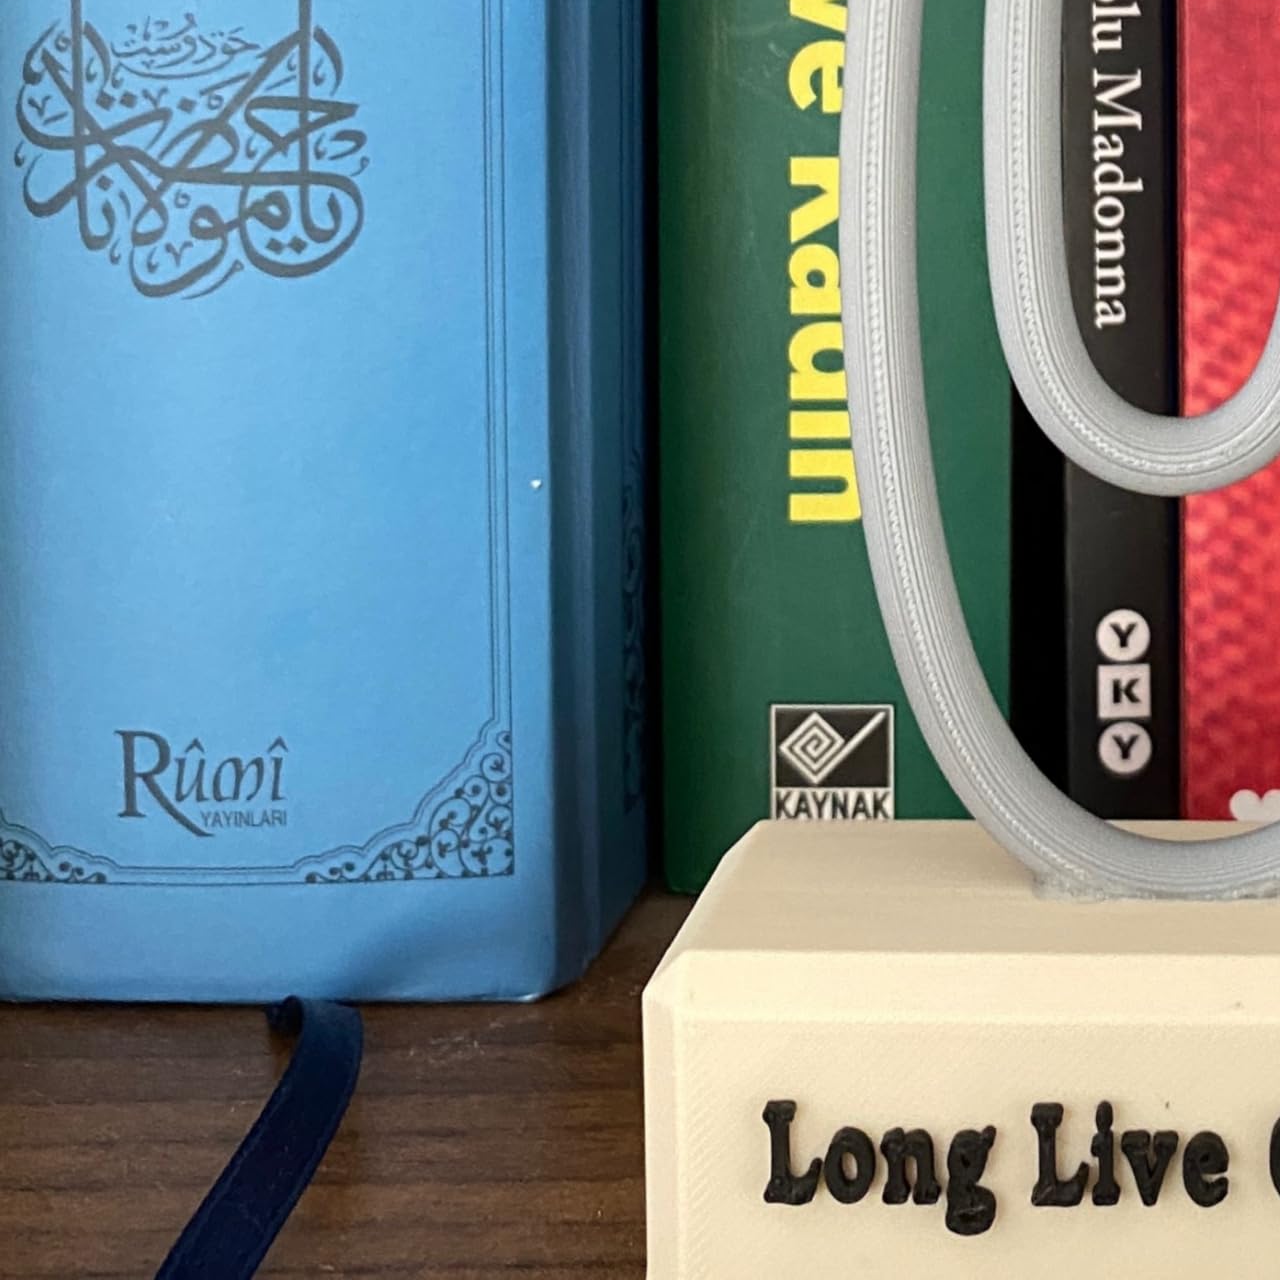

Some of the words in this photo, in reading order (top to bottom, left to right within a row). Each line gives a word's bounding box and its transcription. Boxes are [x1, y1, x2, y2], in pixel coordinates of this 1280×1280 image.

[1091, 68, 1144, 328] Madonna
[115, 729, 288, 837] Rûmî
[200, 808, 288, 828] YAYINLARI
[776, 791, 890, 820] KAYNAK
[762, 1099, 997, 1235] Long
[1031, 1100, 1230, 1208] Live
